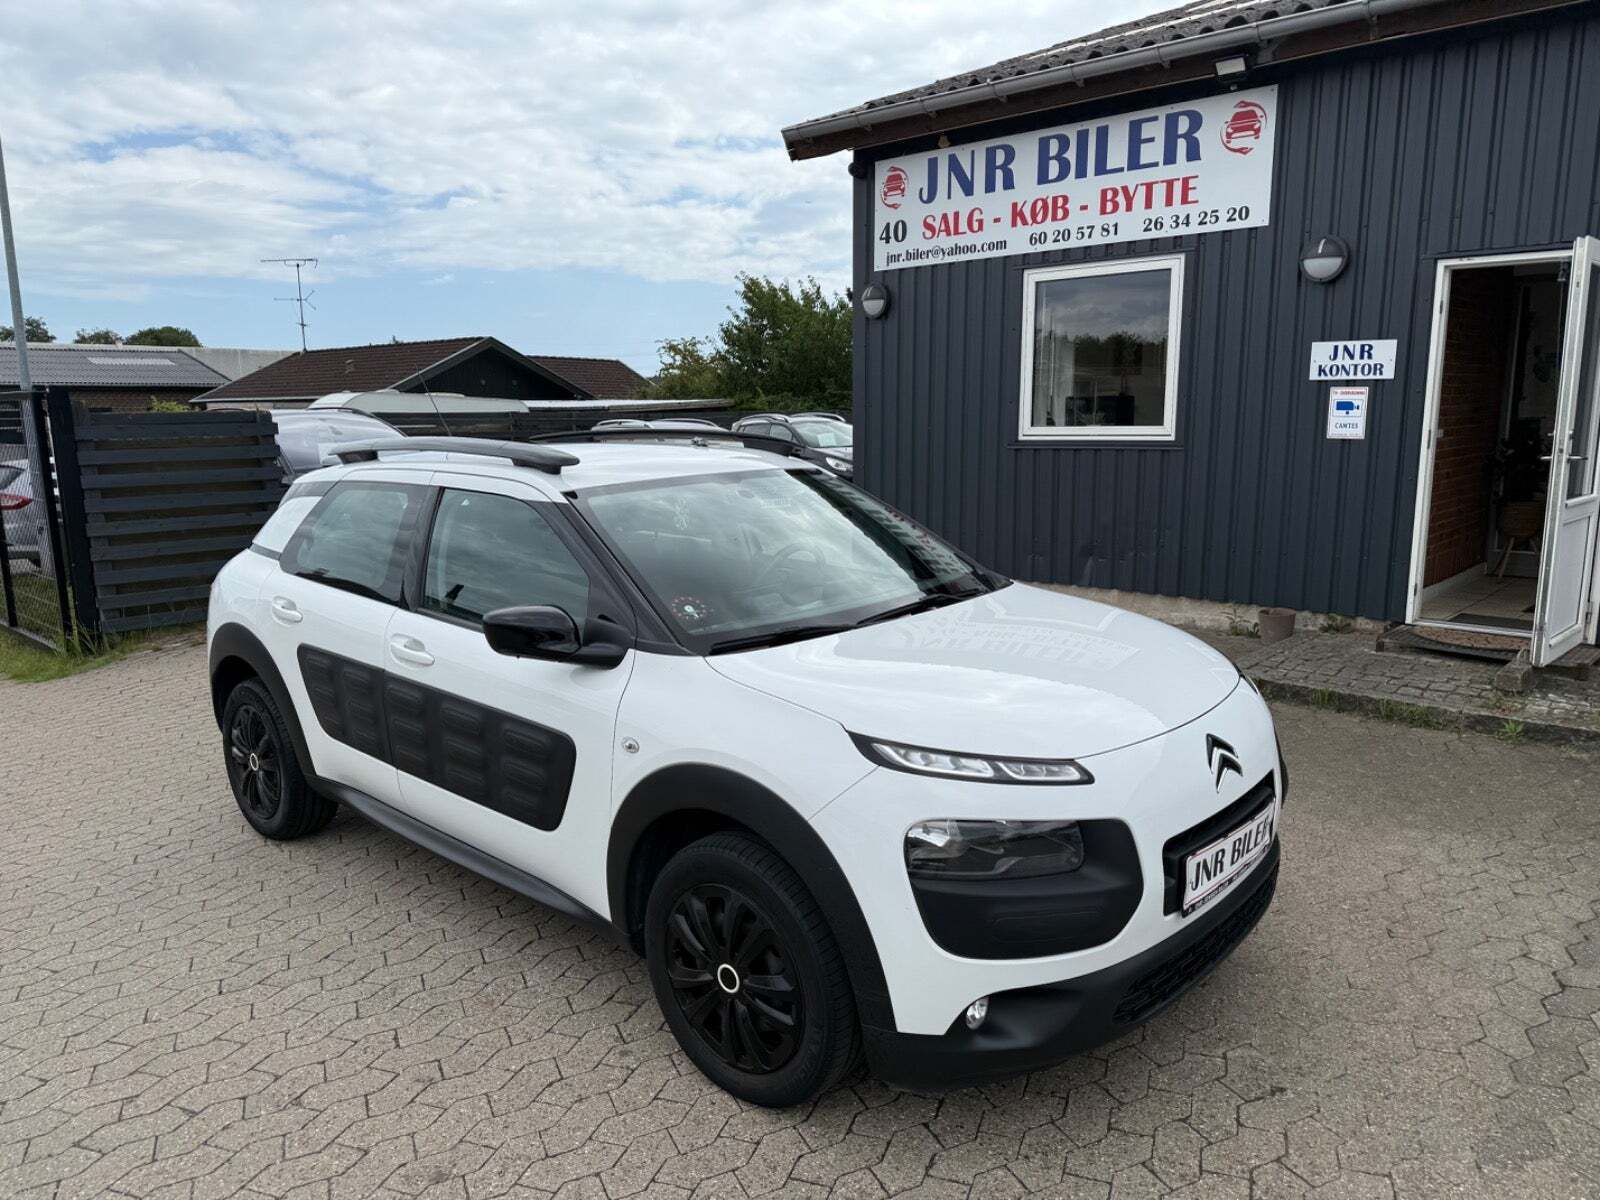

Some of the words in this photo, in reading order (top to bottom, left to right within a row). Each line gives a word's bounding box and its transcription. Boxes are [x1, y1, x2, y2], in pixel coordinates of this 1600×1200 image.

[919, 144, 1016, 205] JNR
[1037, 110, 1203, 185] BILER
[922, 207, 985, 240] SALG
[1010, 194, 1070, 230] KØB
[1099, 175, 1200, 216] BYTTE
[1143, 216, 1164, 232] 26
[1169, 213, 1191, 229] 34
[1198, 210, 1220, 226] 25
[1226, 205, 1250, 222] 20
[879, 219, 908, 245] 40
[1029, 231, 1047, 246] 60
[1052, 228, 1071, 243] 20
[1076, 225, 1096, 240] 57
[1100, 222, 1119, 237] 81
[886, 239, 1007, 267] jnr.biler@yahoo.com
[1329, 343, 1373, 361] JNR
[1317, 362, 1384, 377] KONTOR
[1190, 848, 1226, 891] JNR
